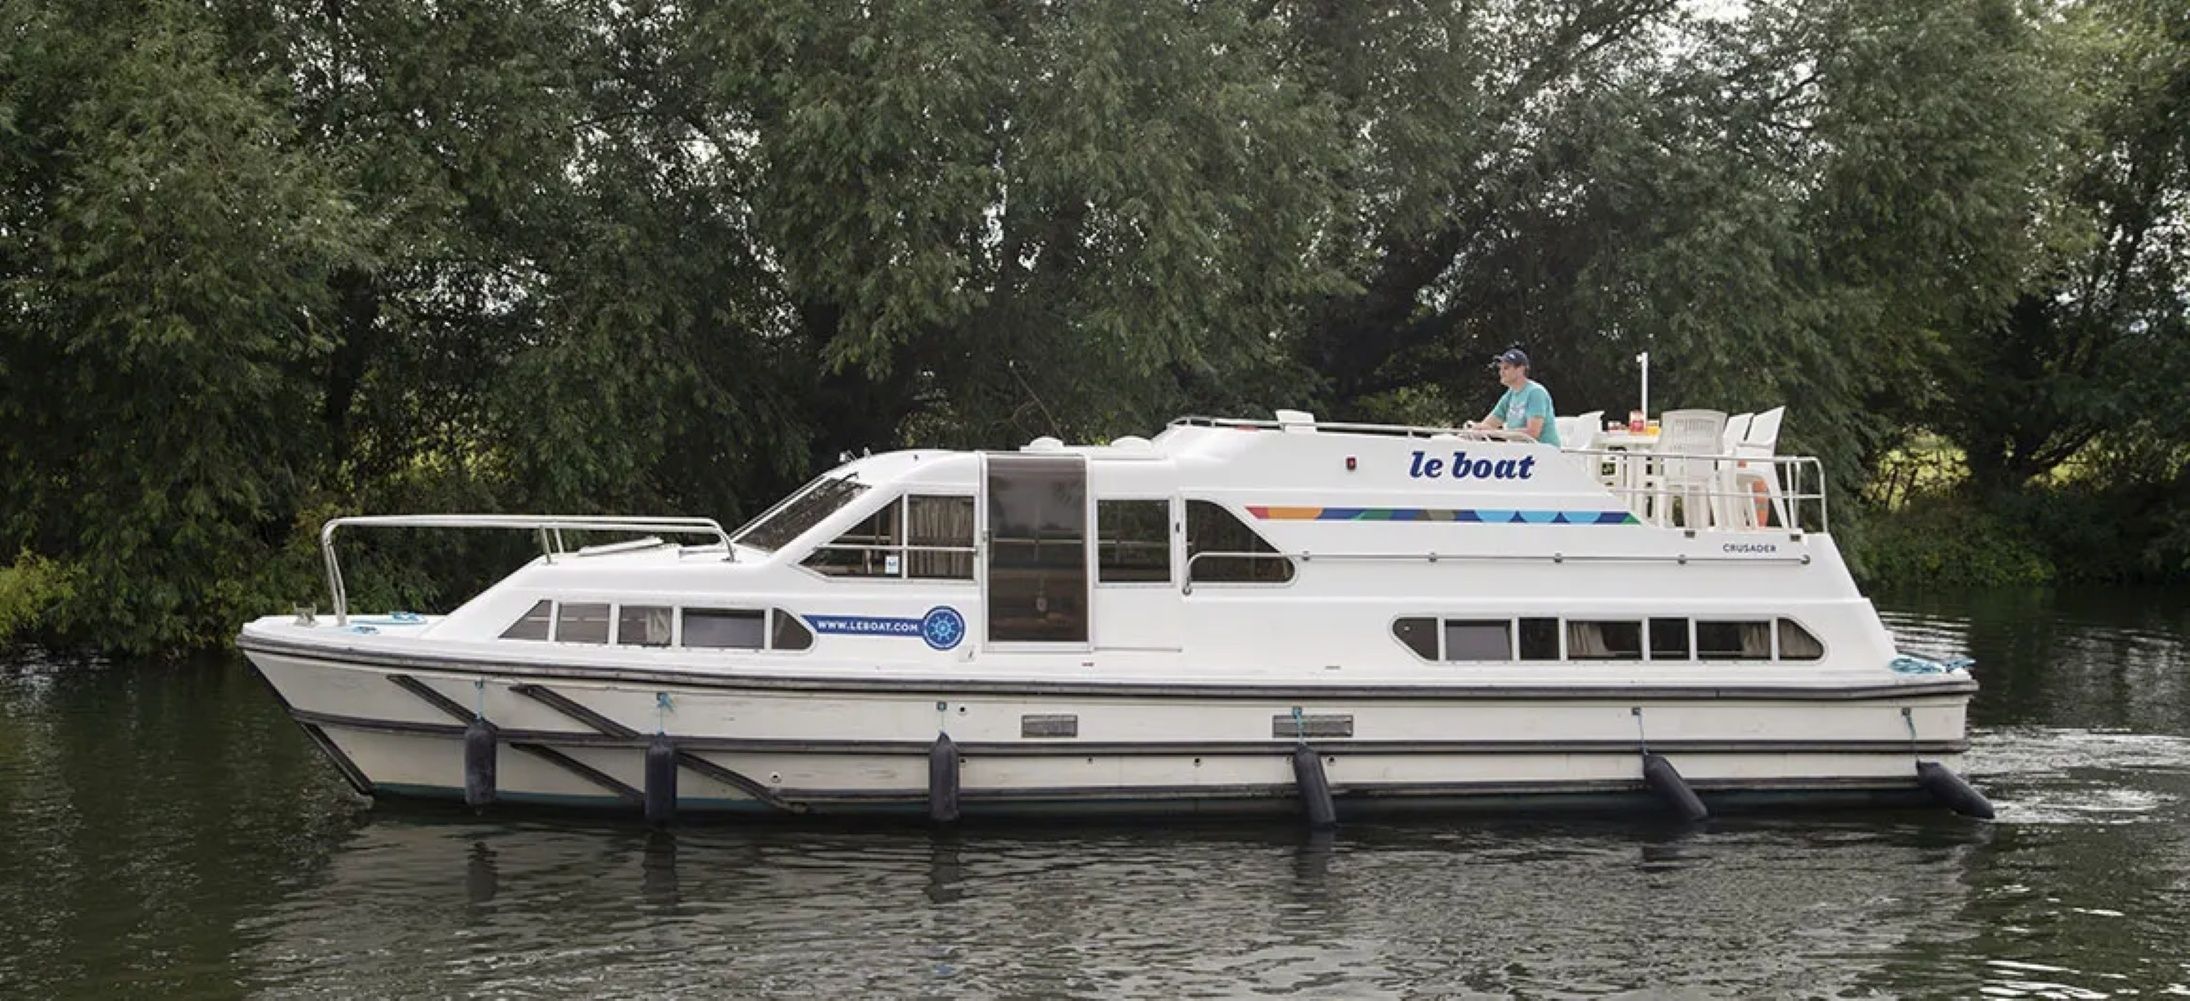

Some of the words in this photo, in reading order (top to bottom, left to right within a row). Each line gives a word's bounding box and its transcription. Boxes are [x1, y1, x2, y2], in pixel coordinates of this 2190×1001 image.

[1409, 450, 1443, 479] le
[1452, 451, 1535, 480] boat
[1722, 543, 1777, 553] CRUSADER
[817, 620, 918, 632] WWW.LEBOAT.COM
